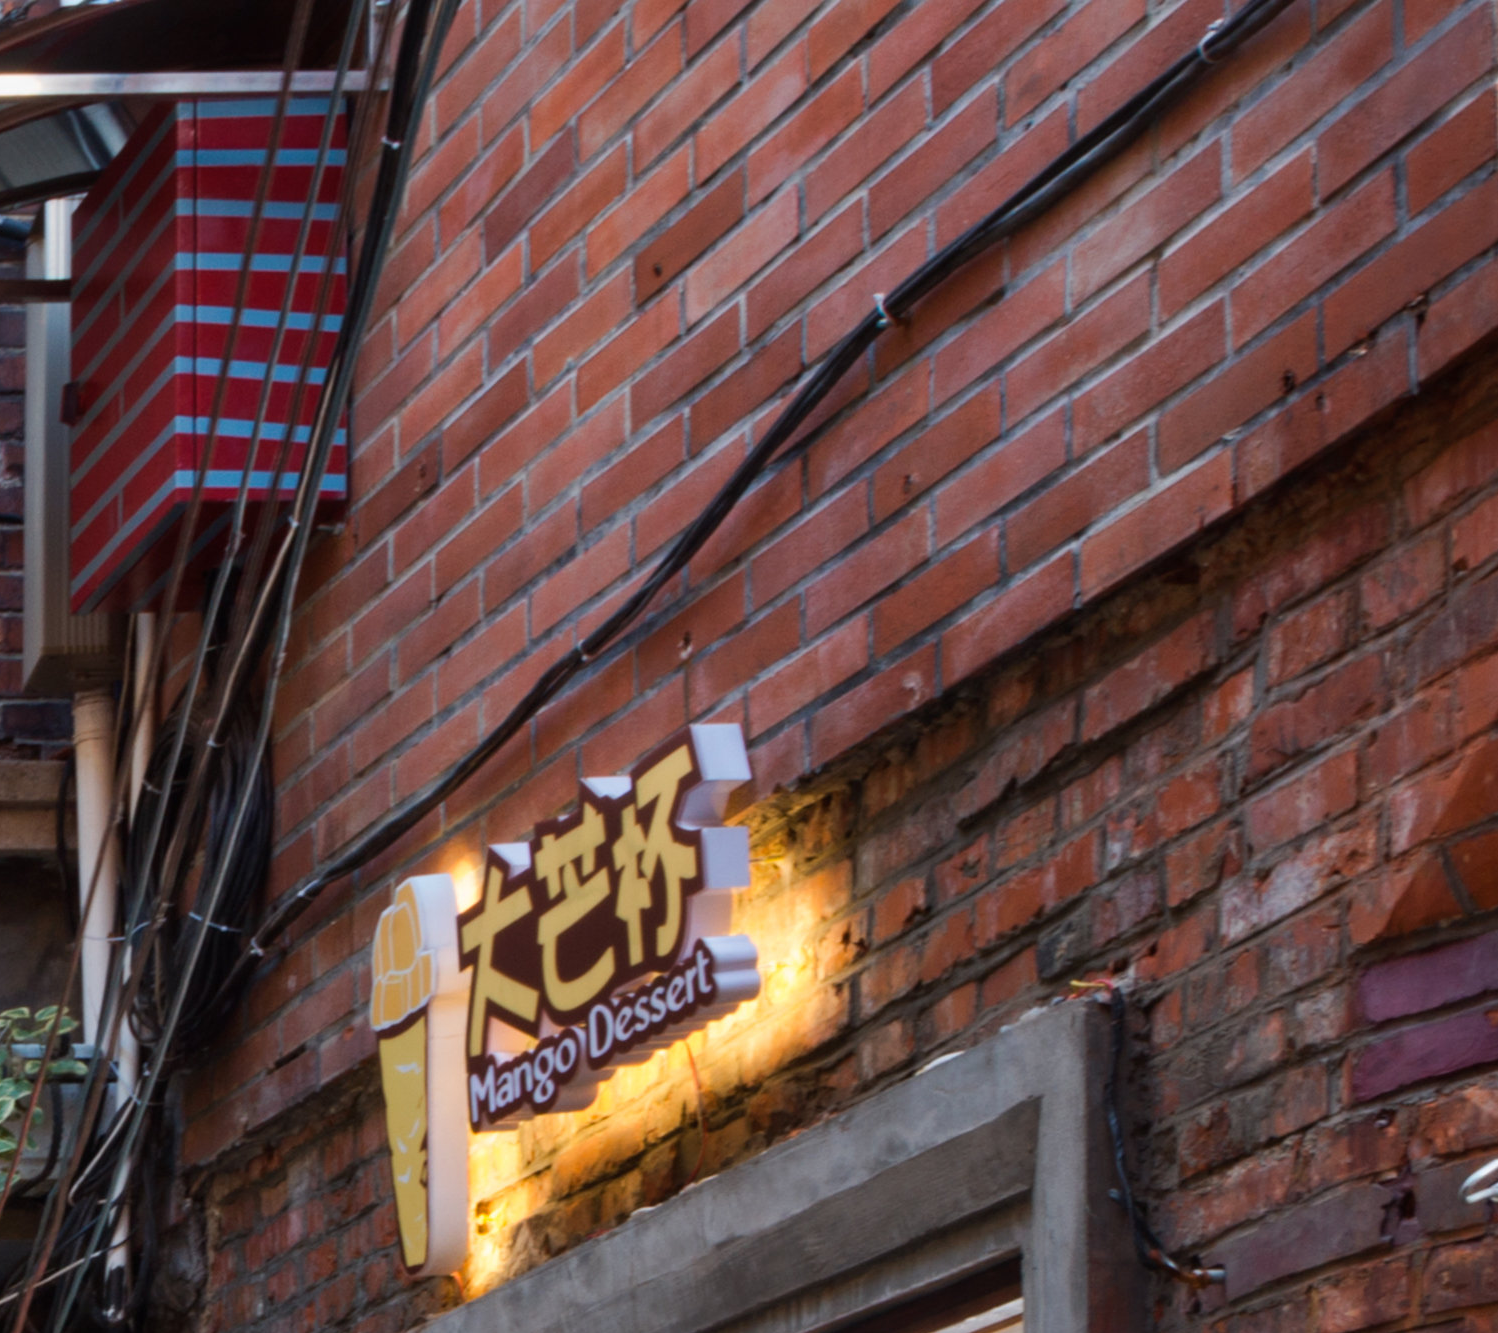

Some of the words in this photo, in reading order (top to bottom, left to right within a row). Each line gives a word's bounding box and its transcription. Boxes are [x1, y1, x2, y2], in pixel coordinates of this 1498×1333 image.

[461, 744, 698, 1058] 大芒杯
[469, 1036, 578, 1124] Mango
[587, 949, 714, 1060] Dessert
